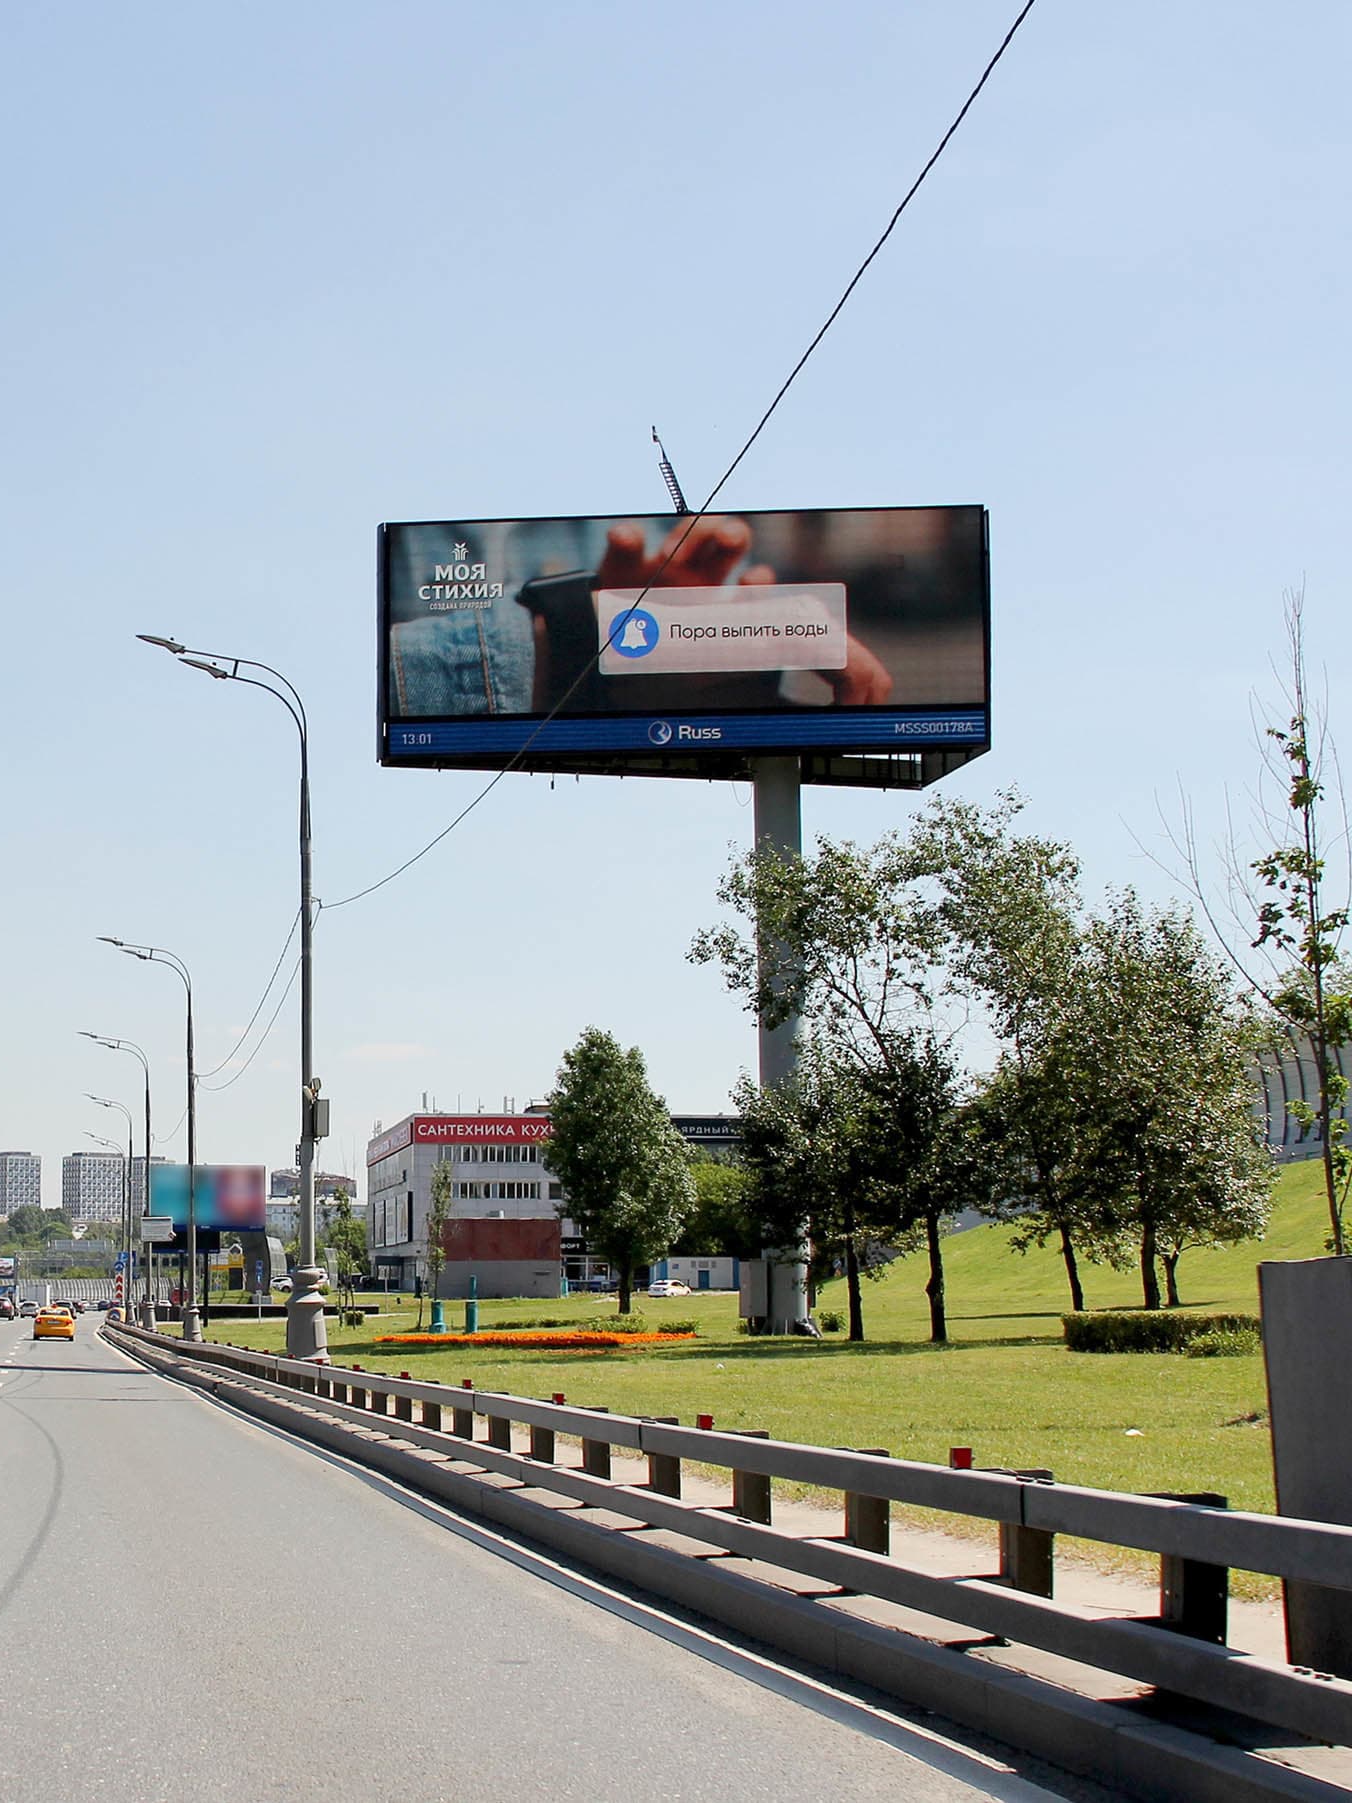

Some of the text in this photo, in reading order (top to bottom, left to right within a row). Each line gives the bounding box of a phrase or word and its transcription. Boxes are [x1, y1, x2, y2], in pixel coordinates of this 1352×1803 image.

[435, 563, 486, 581] МОЯ
[418, 583, 503, 600] СТИХИЯ
[670, 624, 828, 641] Пора выпить воды
[678, 725, 722, 740] Russ
[894, 722, 974, 734] MSSS00178A
[417, 1124, 516, 1136] САНТЕХНИКА
[680, 1126, 729, 1134] ЯРДНЫЙ
